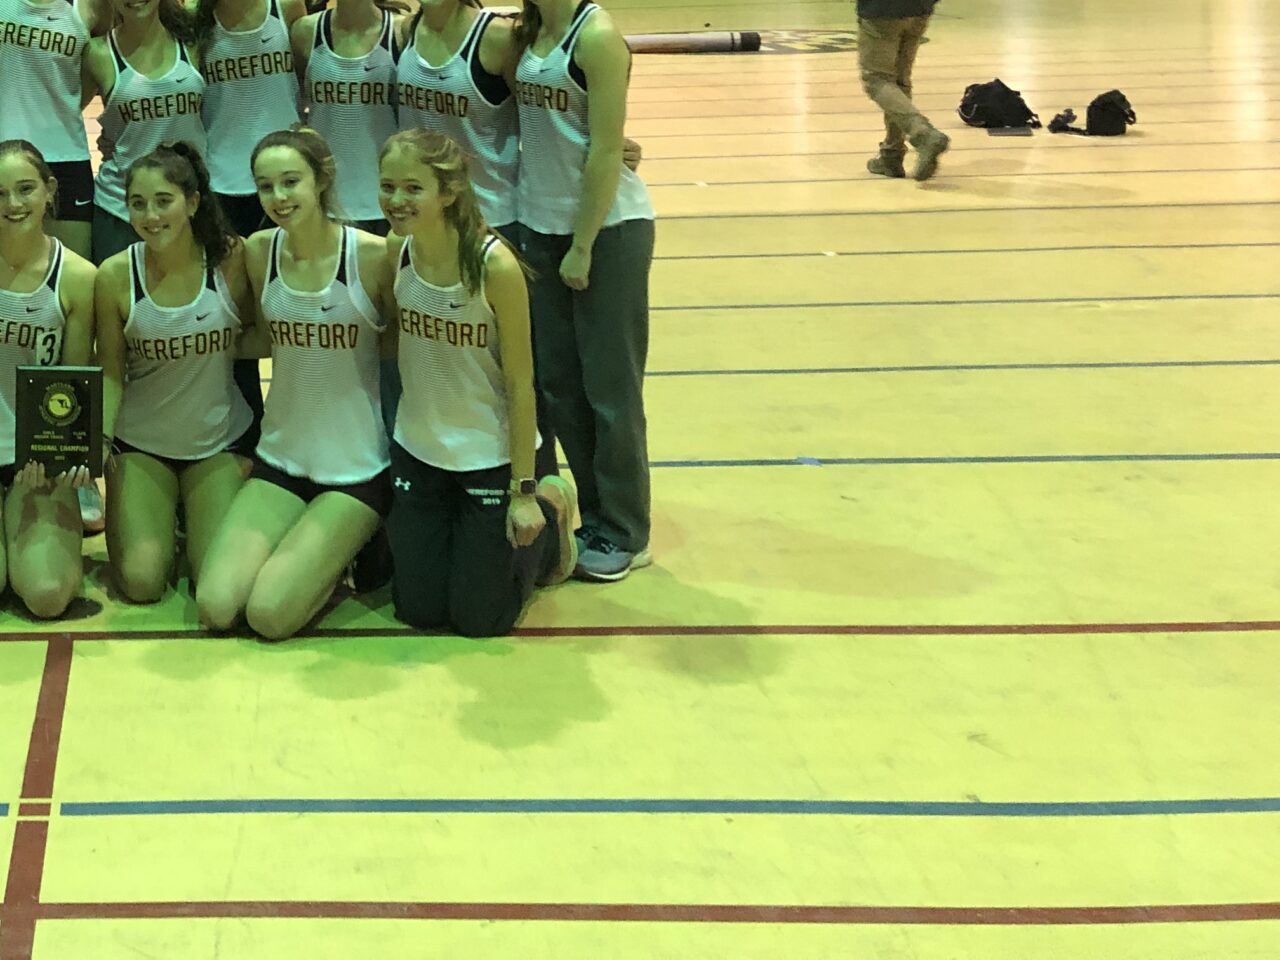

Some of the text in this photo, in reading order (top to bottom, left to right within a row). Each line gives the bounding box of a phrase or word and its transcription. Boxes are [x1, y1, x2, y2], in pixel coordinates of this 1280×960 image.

[205, 51, 295, 84] HEREFORD
[399, 83, 469, 117] EREFORD
[517, 81, 568, 113] EFORD
[134, 327, 232, 360] HEREFORD
[271, 320, 359, 349] EREFORD
[400, 308, 488, 348] EREFORD
[40, 334, 56, 367] 3
